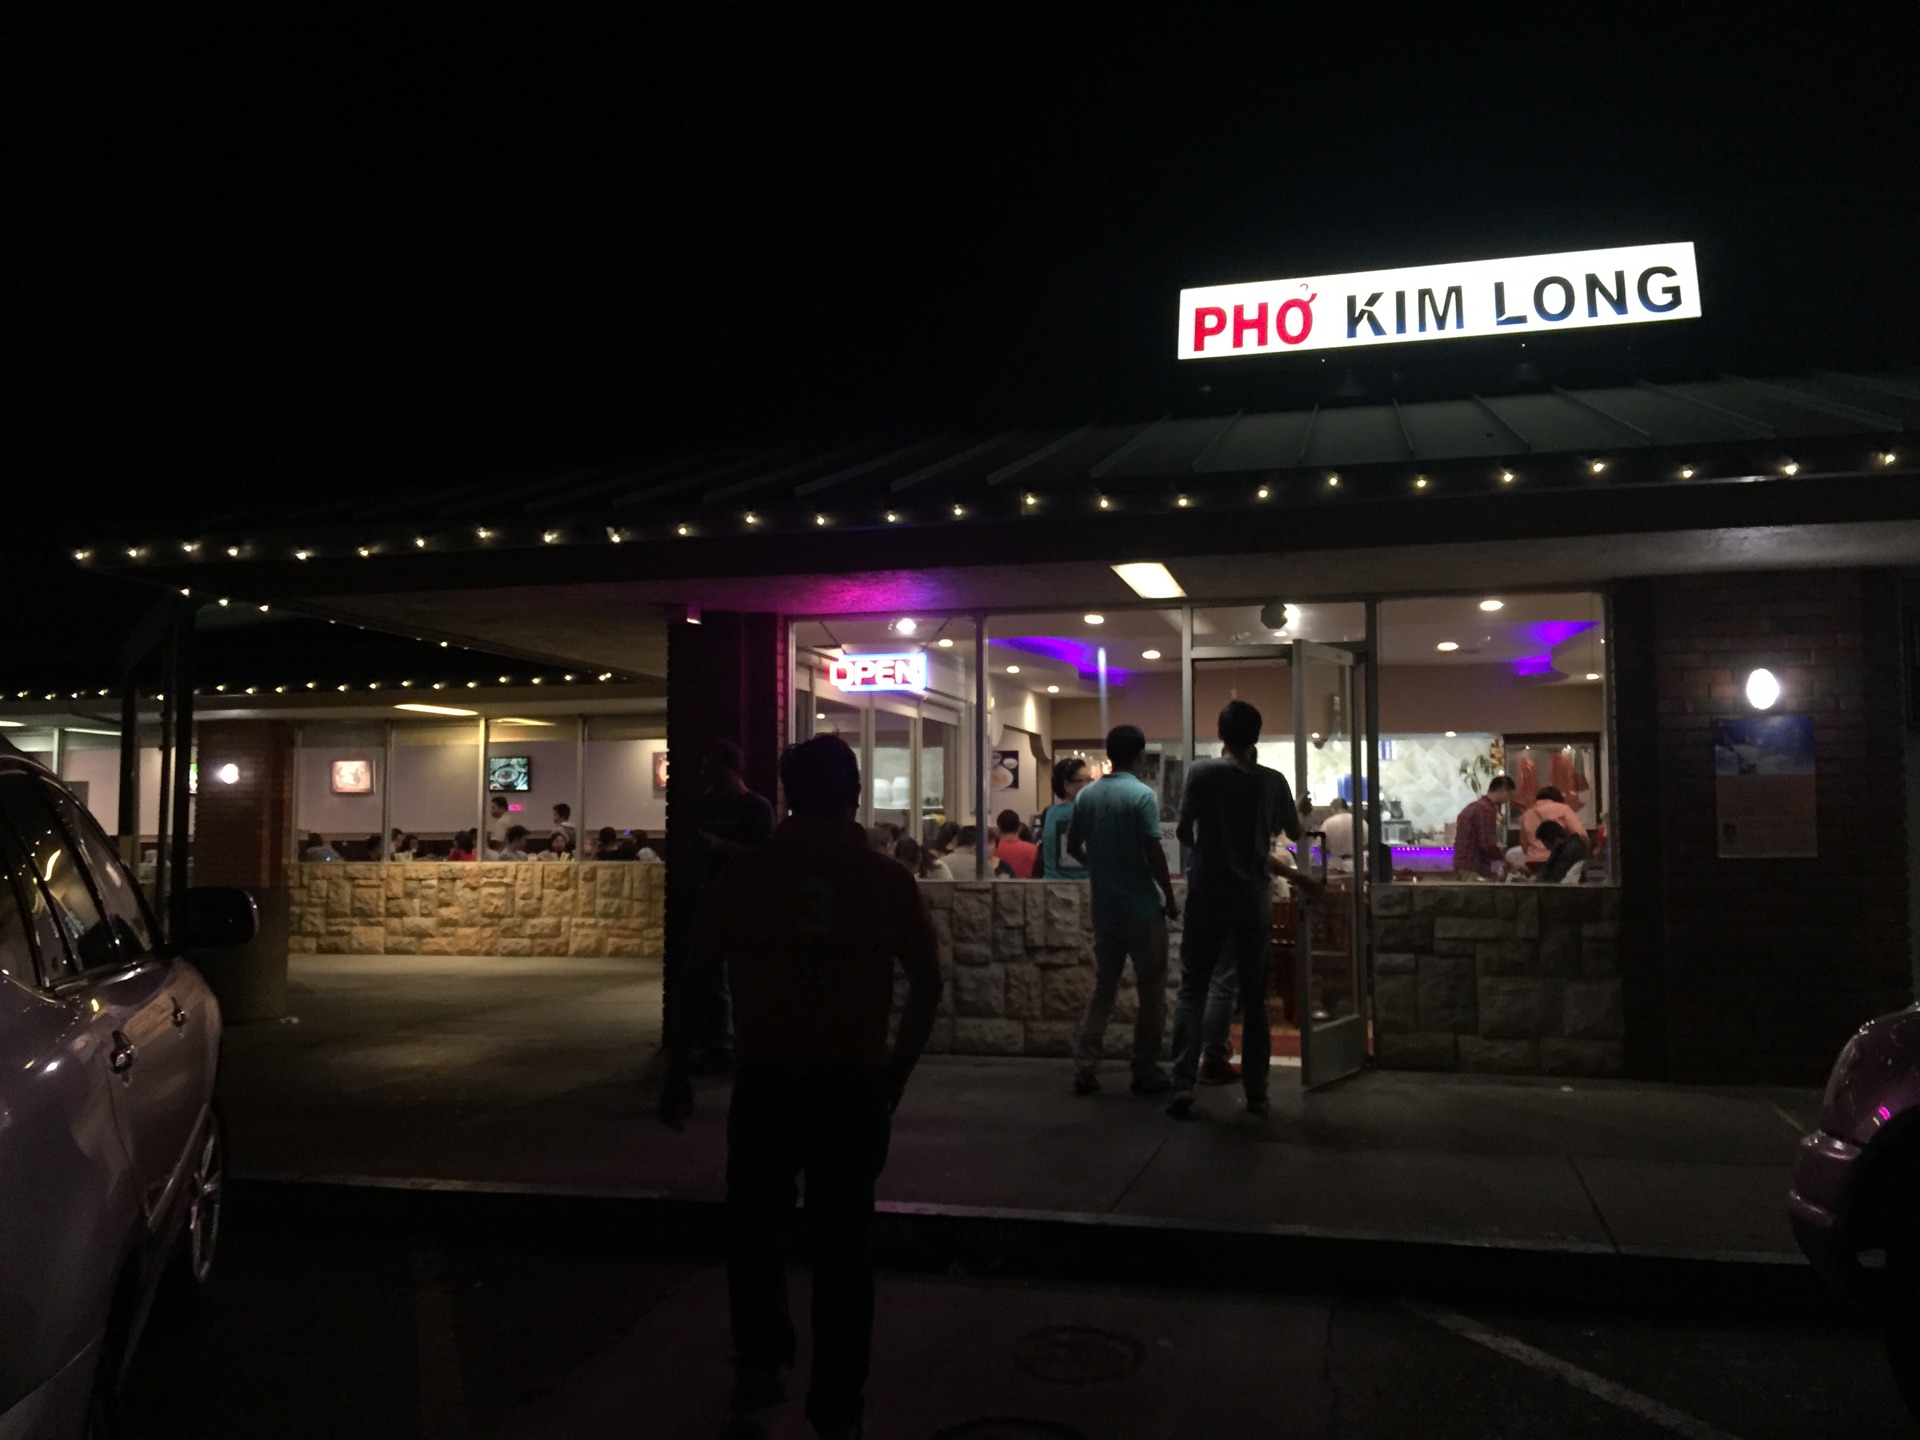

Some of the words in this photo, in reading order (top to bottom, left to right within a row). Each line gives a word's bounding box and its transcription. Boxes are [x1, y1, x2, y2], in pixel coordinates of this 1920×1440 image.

[1194, 283, 1318, 352] PHỞ
[1346, 285, 1465, 339] KIM
[1494, 265, 1684, 326] LONG
[829, 658, 921, 687] OPEN
